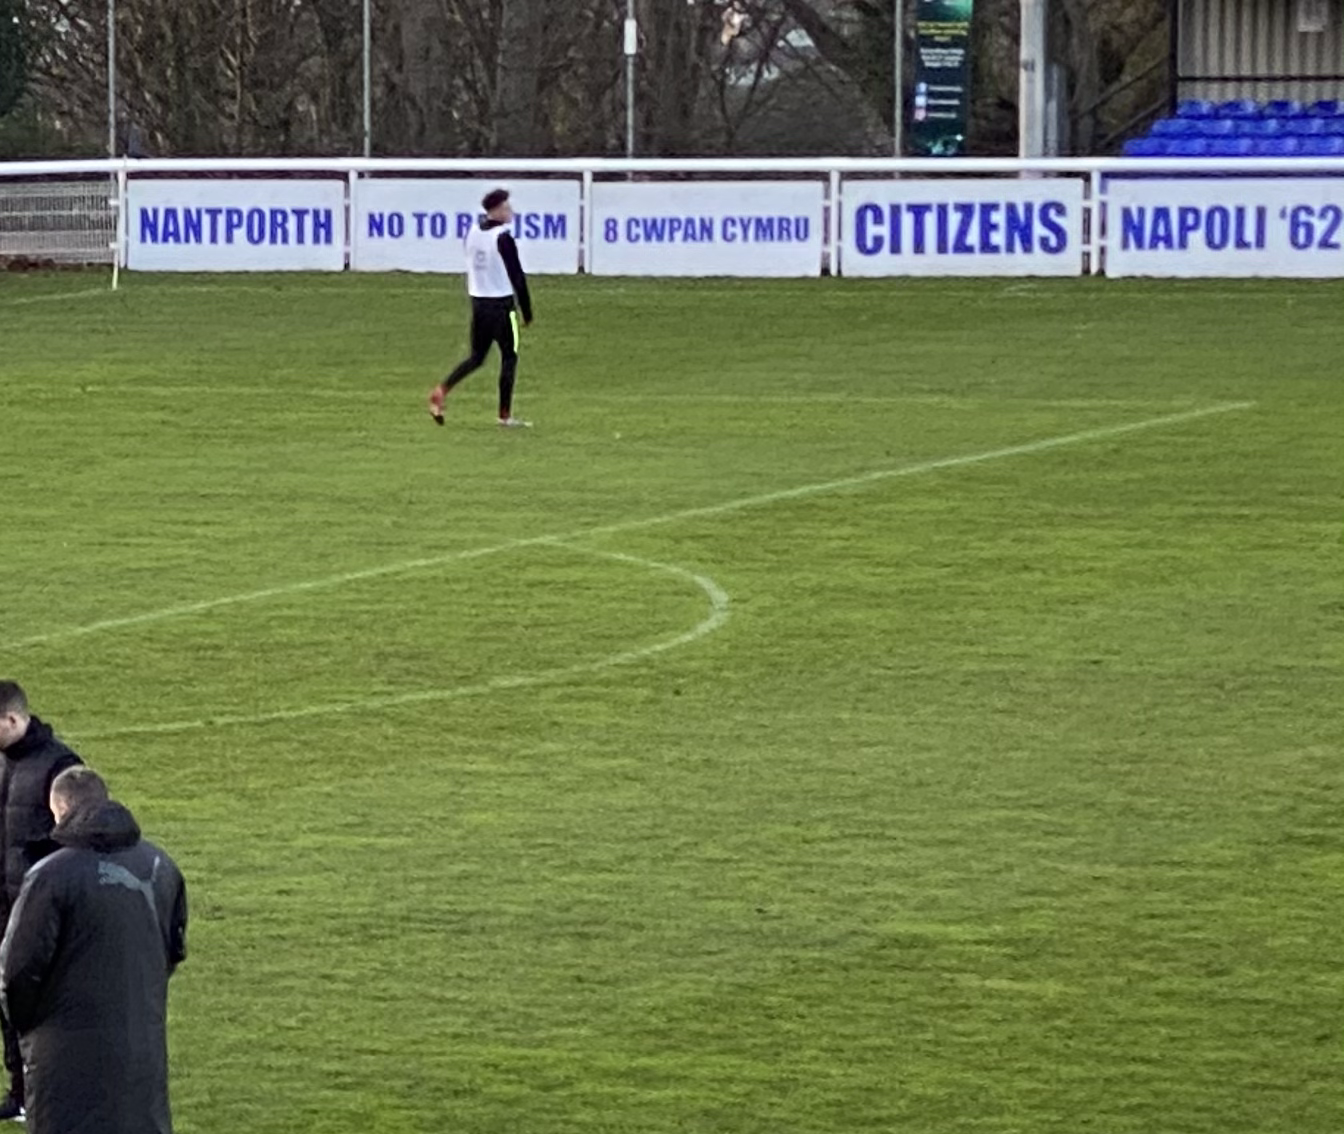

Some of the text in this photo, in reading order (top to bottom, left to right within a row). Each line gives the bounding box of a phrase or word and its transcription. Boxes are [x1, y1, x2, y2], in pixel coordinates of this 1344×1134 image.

[139, 206, 333, 246] NANTPORTH
[368, 211, 566, 240] NO TO RISM
[604, 216, 810, 243] 8 CWPAN CYMRU
[854, 200, 1068, 256] CITIZENS
[1120, 204, 1267, 251] NAPOLI
